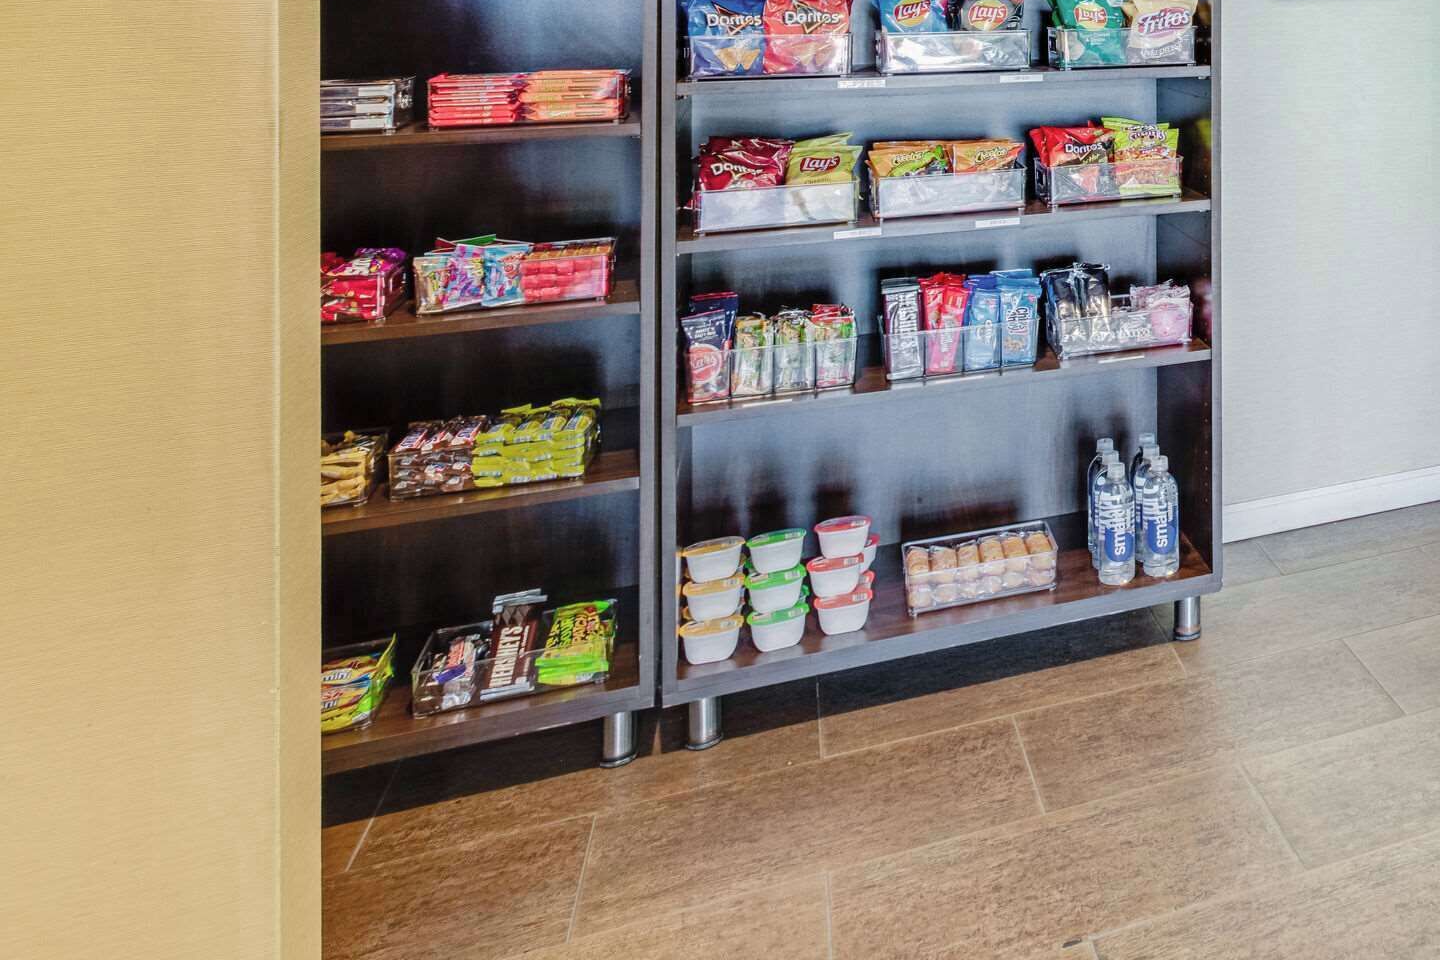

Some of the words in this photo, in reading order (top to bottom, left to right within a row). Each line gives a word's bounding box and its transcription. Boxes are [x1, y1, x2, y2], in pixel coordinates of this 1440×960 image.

[706, 13, 762, 28] Doritos
[783, 10, 841, 27] Doritos
[971, 4, 1007, 23] Lay's
[1140, 10, 1190, 34] Fritos
[1065, 142, 1103, 154] Doritos
[710, 162, 764, 176] Doritos
[801, 156, 839, 172] Lay's
[488, 625, 524, 689] HERSHEY'S
